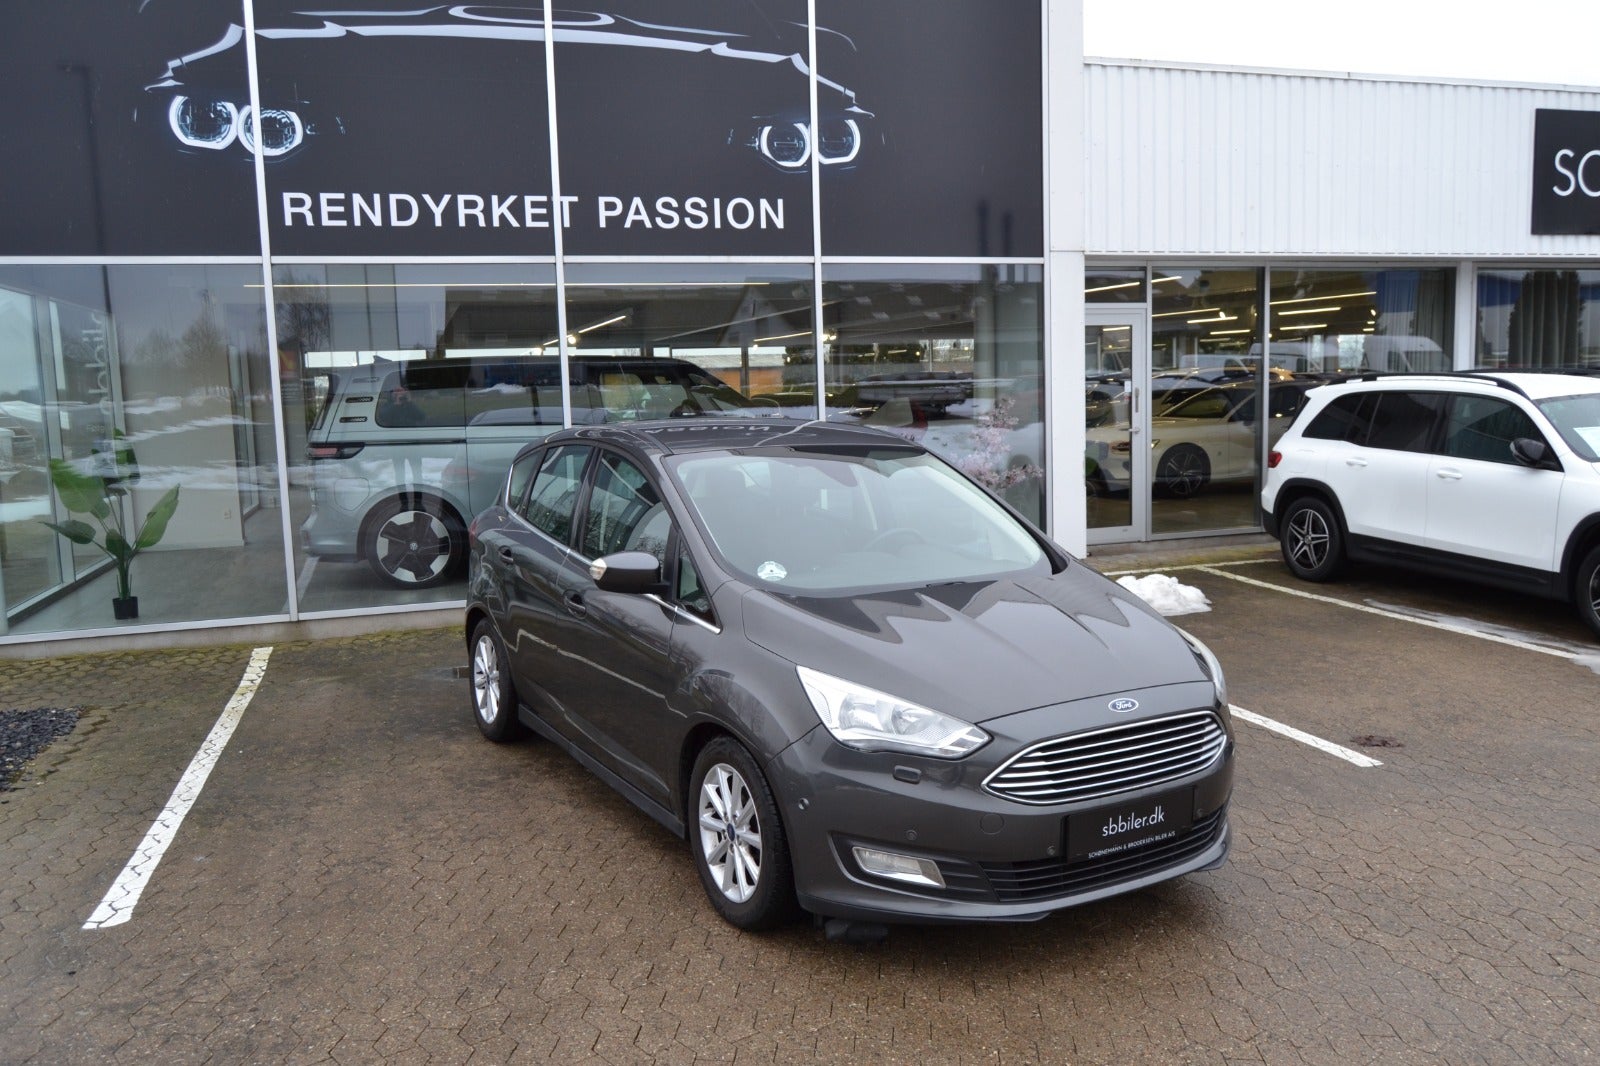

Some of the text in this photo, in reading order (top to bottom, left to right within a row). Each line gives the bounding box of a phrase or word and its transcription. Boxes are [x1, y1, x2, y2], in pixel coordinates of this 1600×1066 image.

[283, 190, 785, 230] RENDYRKET PASSION
[1115, 701, 1132, 710] Ford
[1101, 805, 1165, 837] sbbiler.dk
[1154, 833, 1168, 842] BILER
